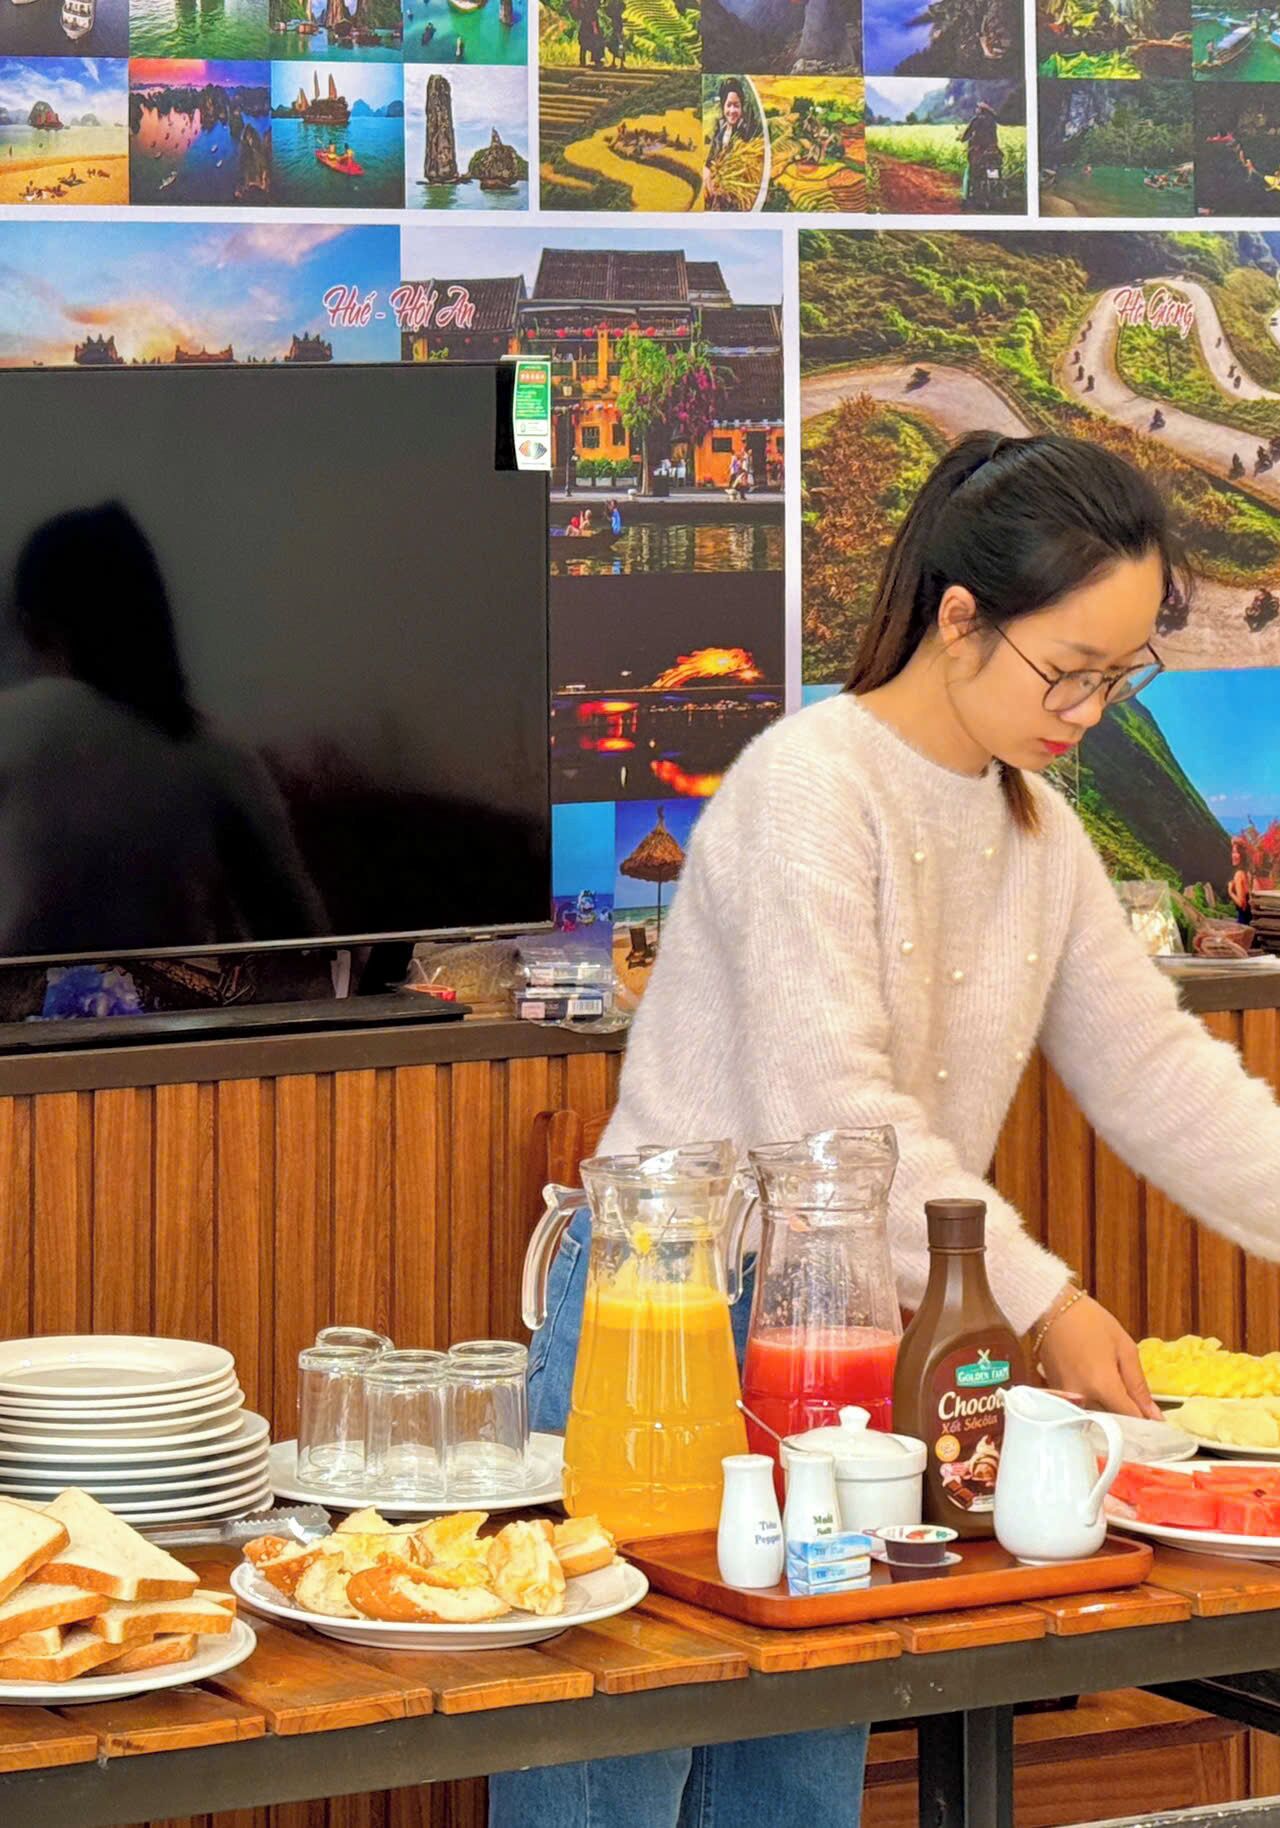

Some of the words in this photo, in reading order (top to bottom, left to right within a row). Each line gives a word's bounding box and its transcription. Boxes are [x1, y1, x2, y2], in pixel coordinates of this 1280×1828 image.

[323, 284, 377, 328] Huế
[389, 285, 438, 332] Hội
[435, 286, 475, 328] An
[1147, 287, 1195, 340] Giang
